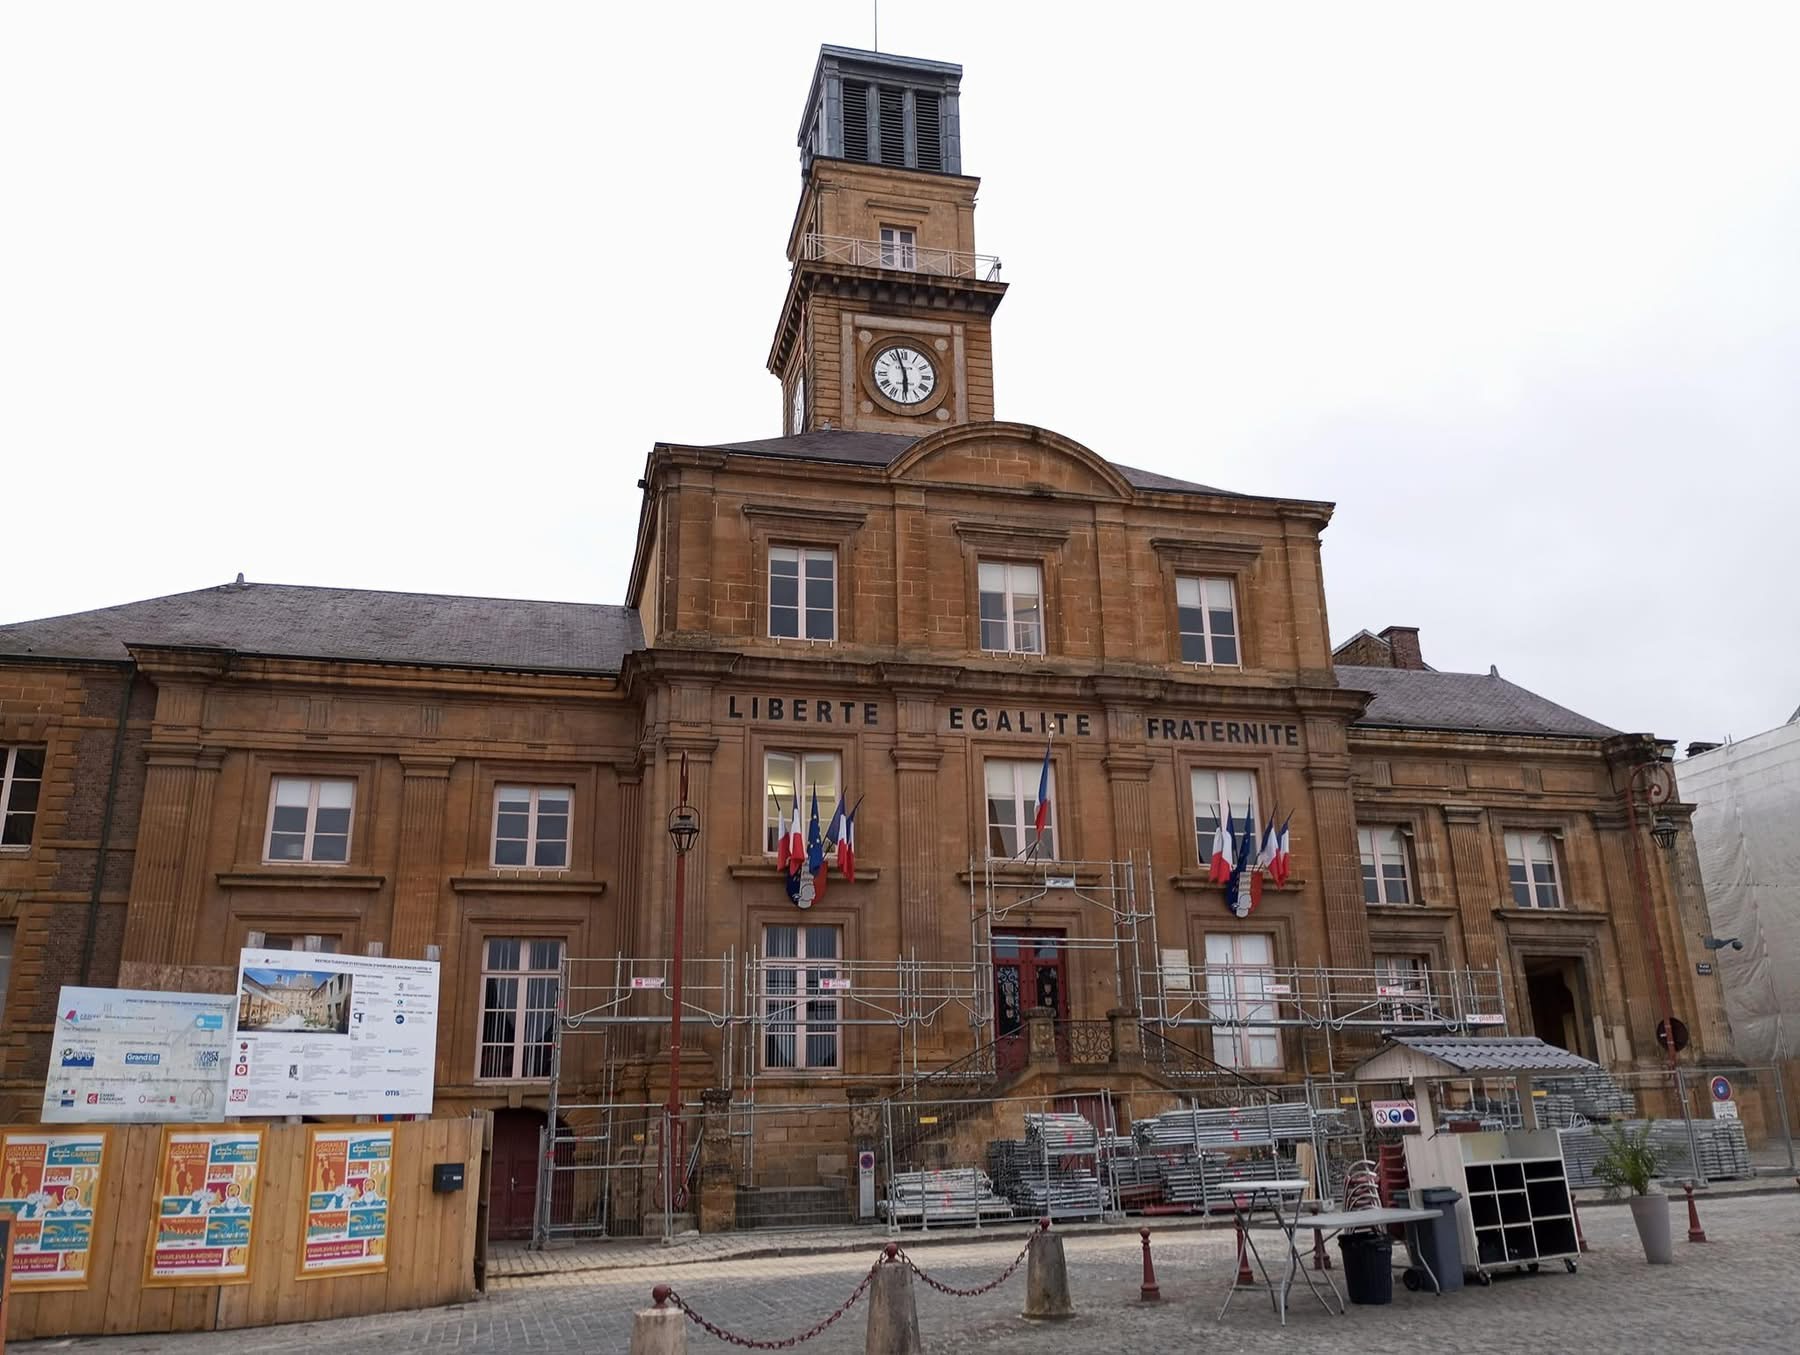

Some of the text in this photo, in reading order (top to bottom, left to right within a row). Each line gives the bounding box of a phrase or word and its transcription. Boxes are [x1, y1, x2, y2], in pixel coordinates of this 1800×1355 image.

[729, 695, 878, 725] LIBERTE
[949, 707, 1091, 736] EGALITE
[1147, 718, 1299, 746] FRATERNITE
[385, 1089, 400, 1097] OTIS
